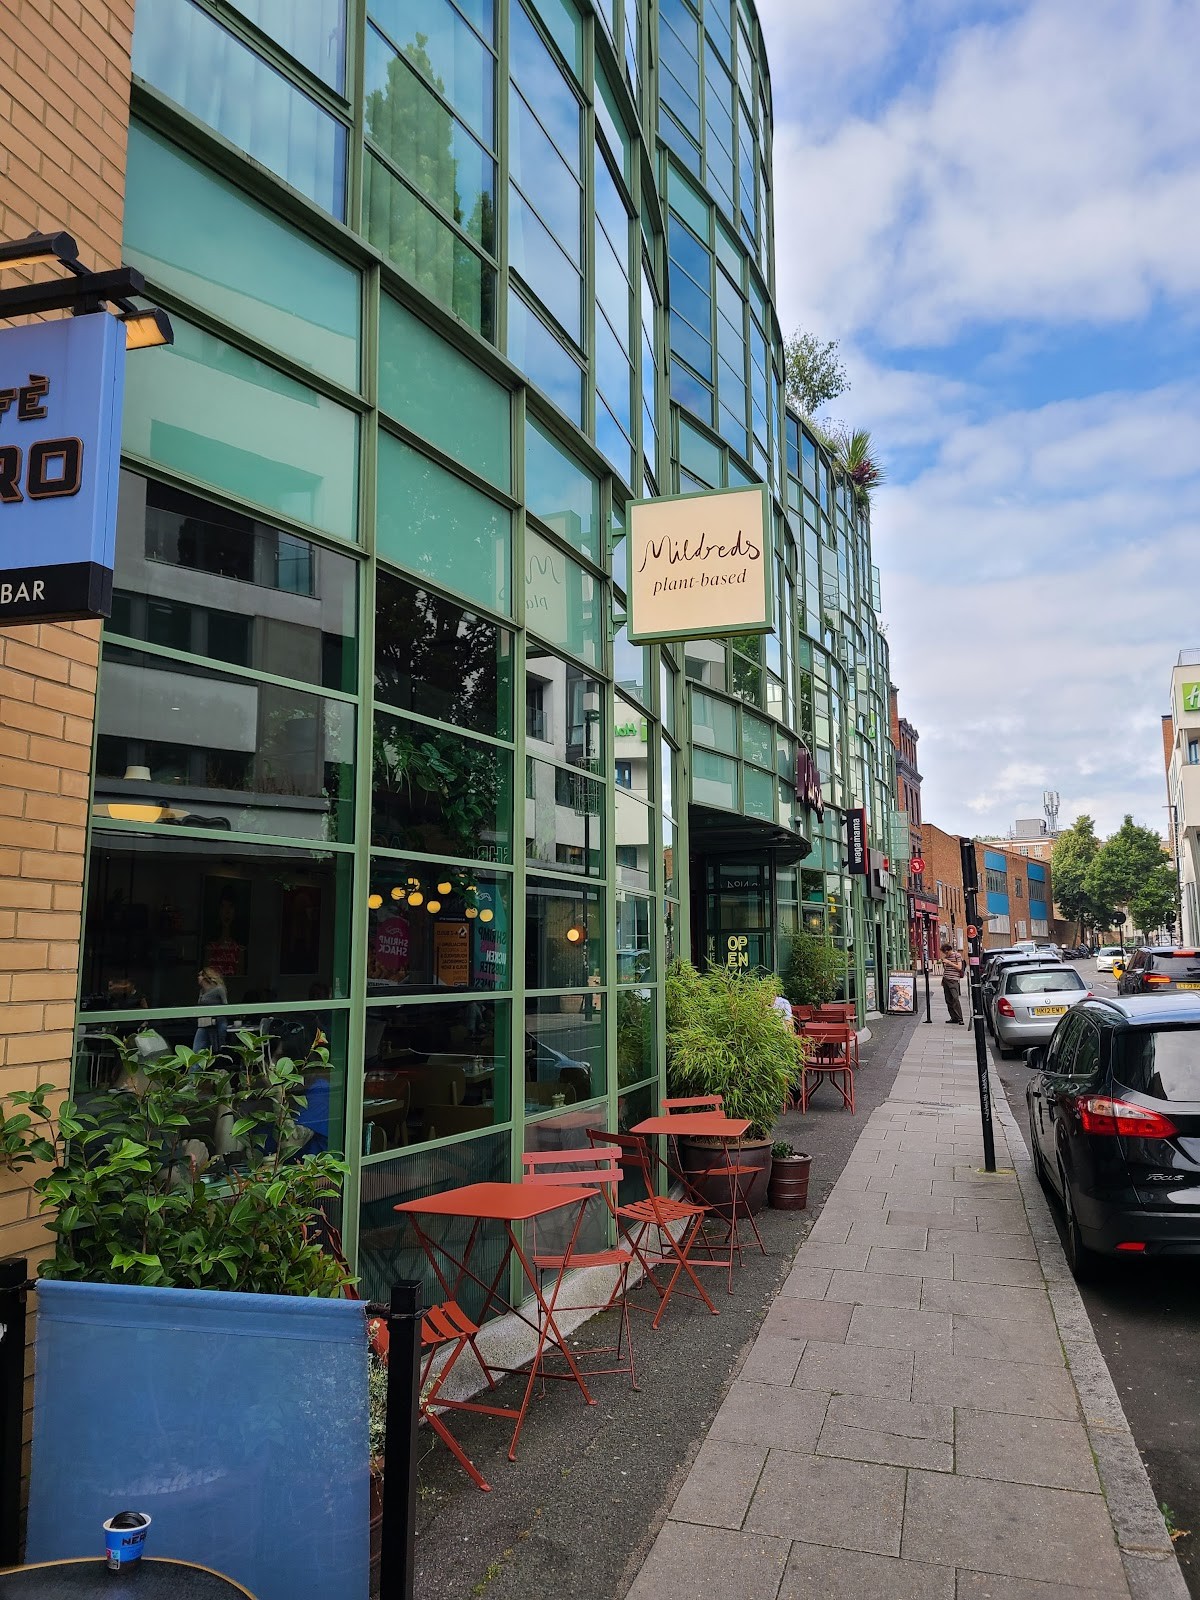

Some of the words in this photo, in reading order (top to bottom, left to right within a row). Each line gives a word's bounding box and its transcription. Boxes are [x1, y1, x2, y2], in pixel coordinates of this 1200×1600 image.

[637, 530, 760, 572] Mildreds
[0, 580, 45, 604] BAR
[653, 569, 747, 596] plant-based
[853, 818, 861, 864] wagamama
